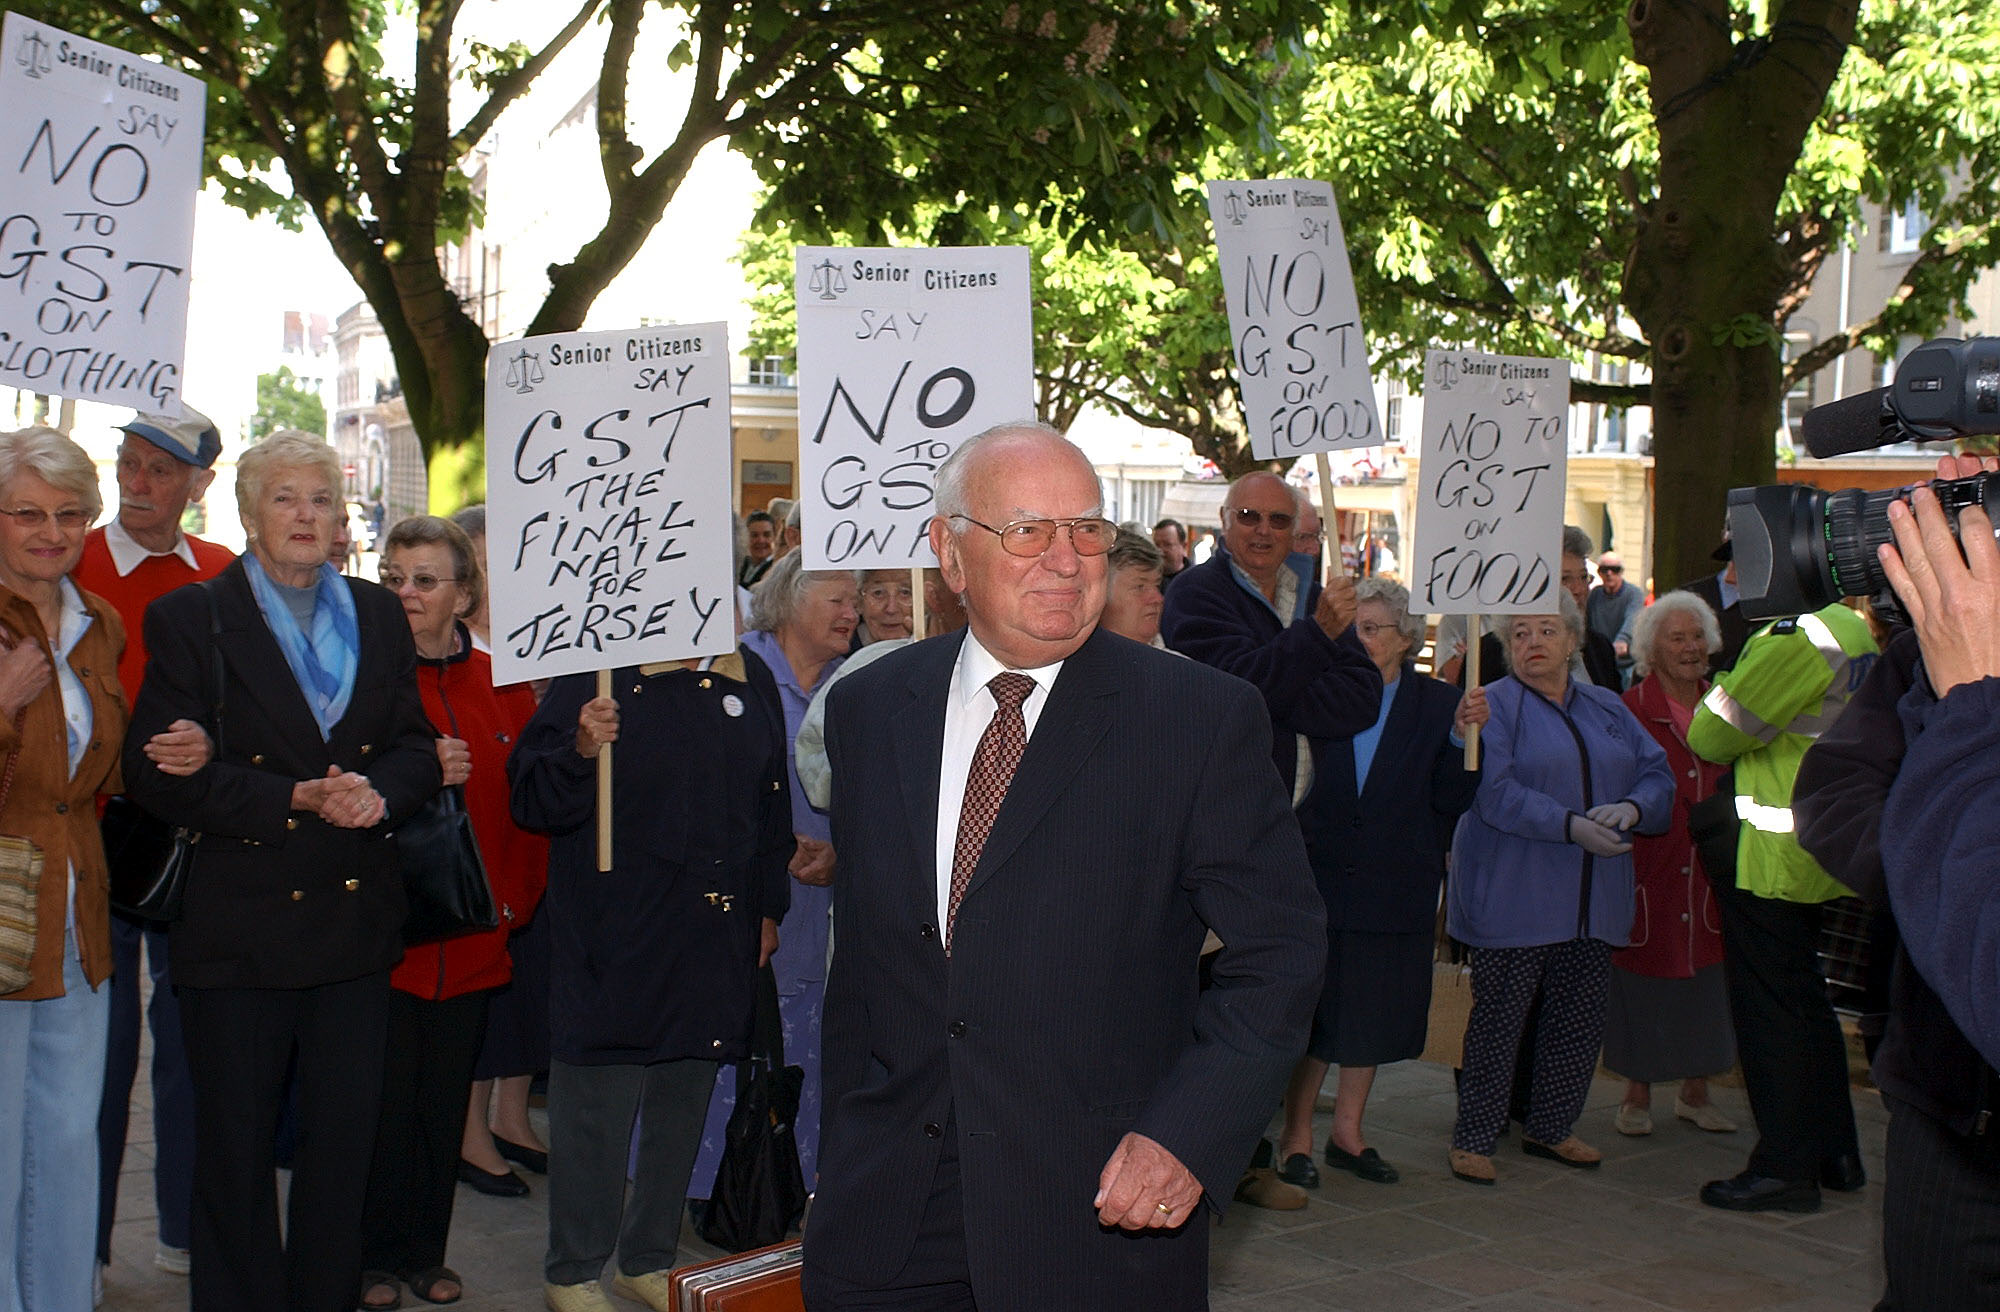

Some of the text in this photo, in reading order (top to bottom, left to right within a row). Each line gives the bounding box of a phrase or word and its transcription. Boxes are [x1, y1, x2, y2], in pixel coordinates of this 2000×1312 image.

[57, 41, 180, 101] Senior Citizens
[118, 104, 178, 147] SAY
[19, 118, 148, 207] NO
[1247, 189, 1286, 207] Senior
[62, 211, 116, 236] TO
[1300, 217, 1330, 246] SAY
[0, 214, 184, 323] GST
[852, 259, 998, 291] Senior Citizens
[1244, 251, 1325, 317] NO
[36, 298, 111, 335] ON
[855, 309, 928, 342] SAY
[550, 335, 703, 366] Senior Citizens
[1240, 322, 1355, 378] GST
[1461, 357, 1550, 380] Senior Citizens
[633, 364, 694, 395] SAY
[1283, 375, 1329, 405] ON
[1502, 387, 1537, 408] SAY
[812, 360, 976, 446] NO
[514, 397, 712, 485] GST
[896, 439, 950, 460] TO
[1270, 399, 1372, 458] FOOD
[1438, 412, 1560, 461] NO TO
[565, 468, 665, 512] THE
[821, 455, 937, 510] GS
[1435, 459, 1551, 513] GST
[825, 520, 896, 563] ON
[1464, 517, 1501, 540] ON
[586, 568, 647, 603] FOR
[1425, 546, 1550, 606] FOOD
[507, 587, 722, 661] JERSEY
